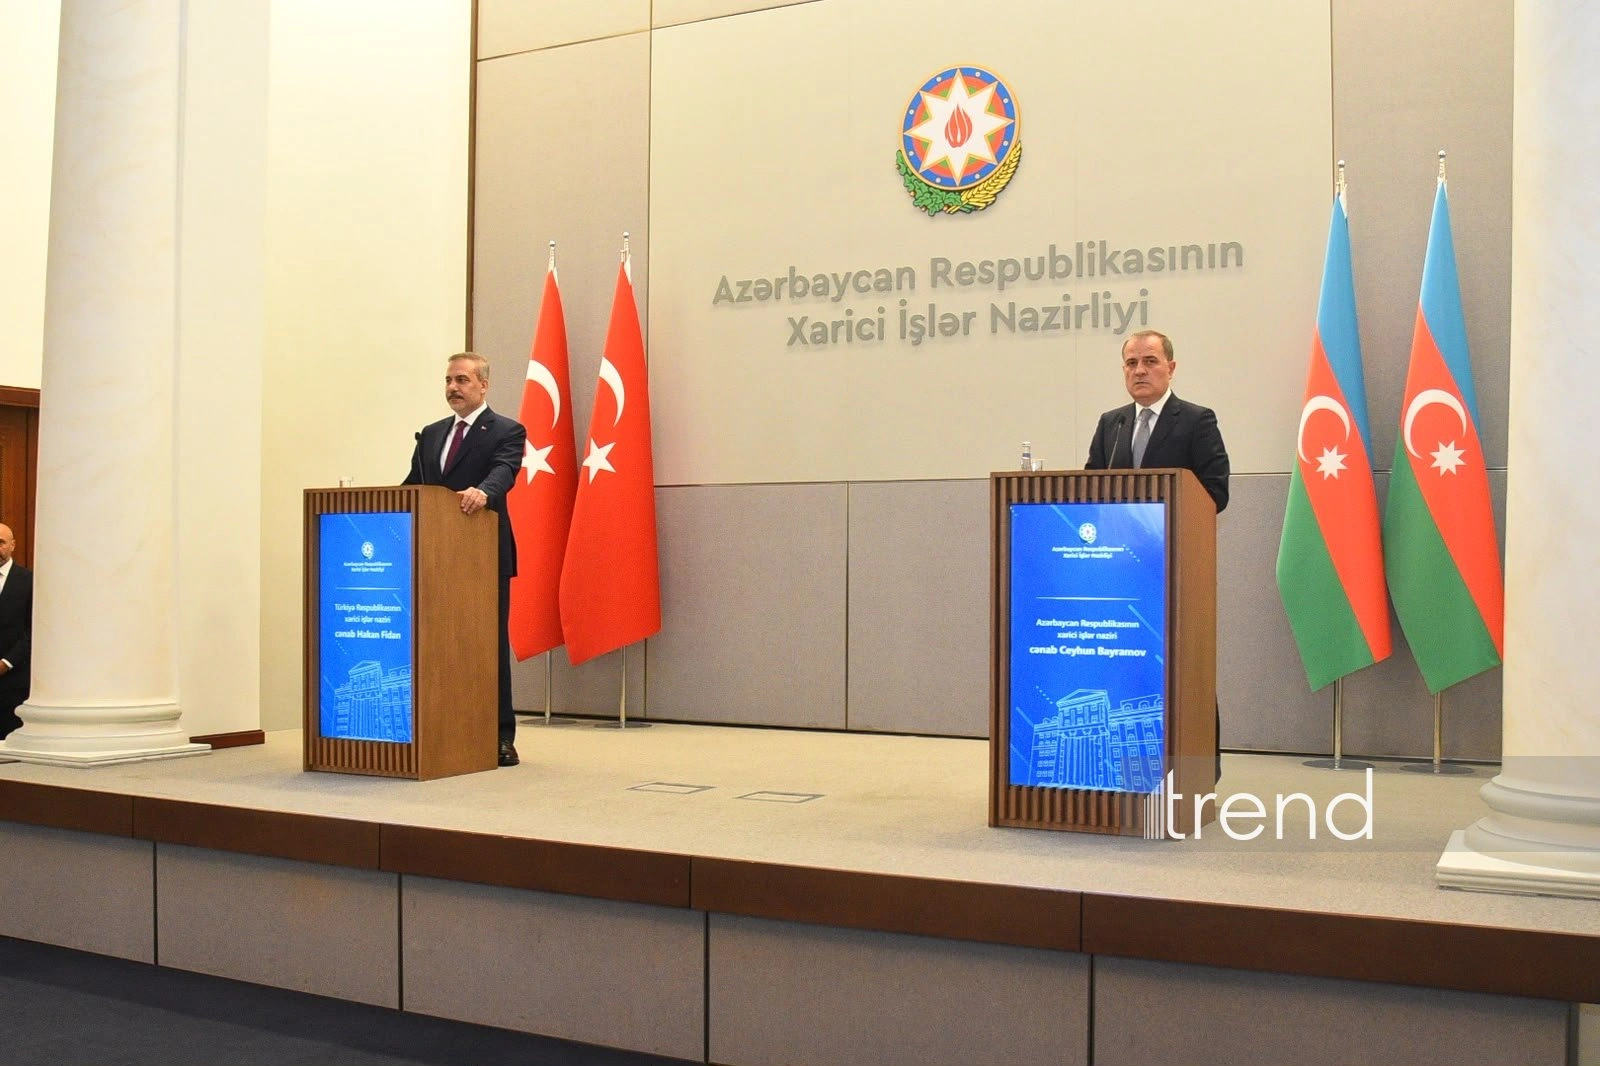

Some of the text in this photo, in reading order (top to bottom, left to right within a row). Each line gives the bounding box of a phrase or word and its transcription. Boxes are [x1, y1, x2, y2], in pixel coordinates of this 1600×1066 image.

[712, 240, 1243, 305] Azərbaycan Respublikasının
[787, 288, 1149, 347] Xarici İşlər Nazirliyi
[1036, 618, 1079, 629] Azərbaycan
[357, 630, 380, 638] Hakan
[381, 630, 401, 639] Fidan
[1029, 645, 1147, 659] cənab Ceyhun Bayramov
